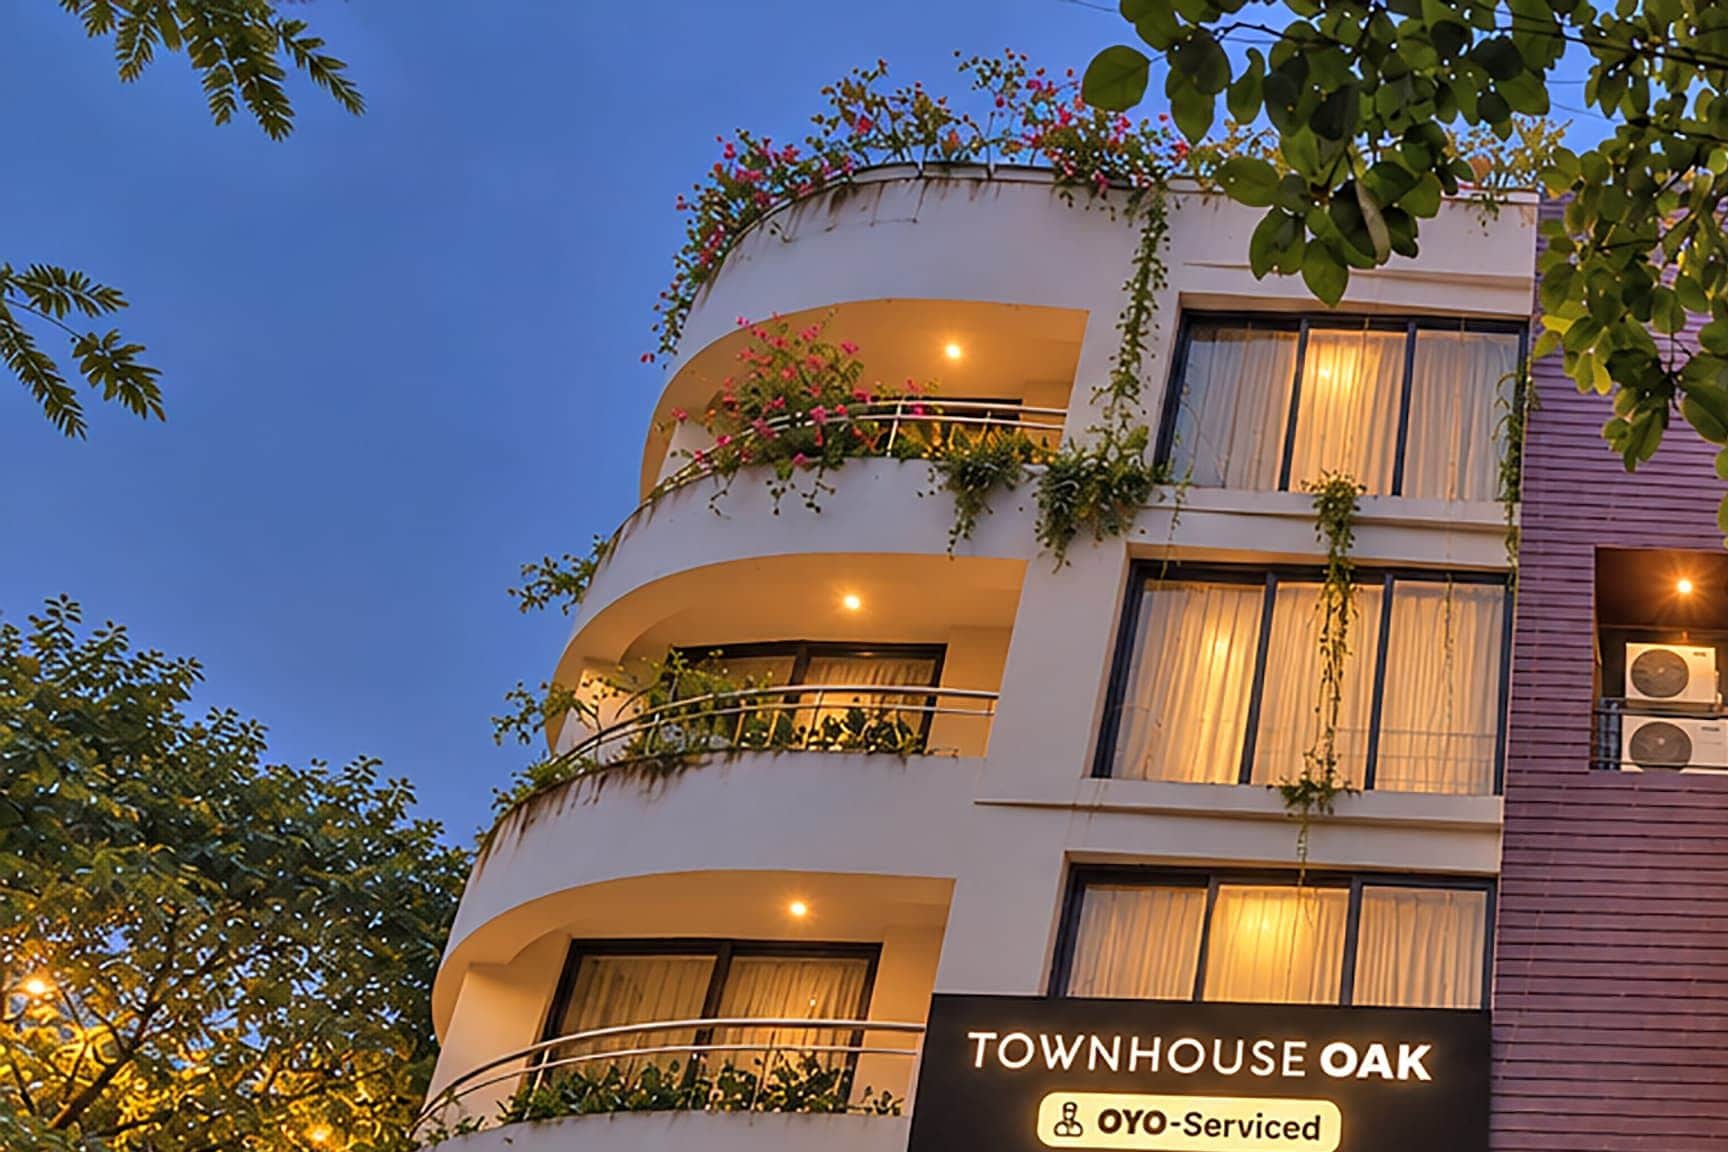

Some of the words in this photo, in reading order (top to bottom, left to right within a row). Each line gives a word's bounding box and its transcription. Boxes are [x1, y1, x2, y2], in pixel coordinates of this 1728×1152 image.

[966, 1030, 1308, 1078] TOWNHOUSE
[1318, 1040, 1433, 1082] OAK
[1096, 1107, 1322, 1142] OYO-Serviced
